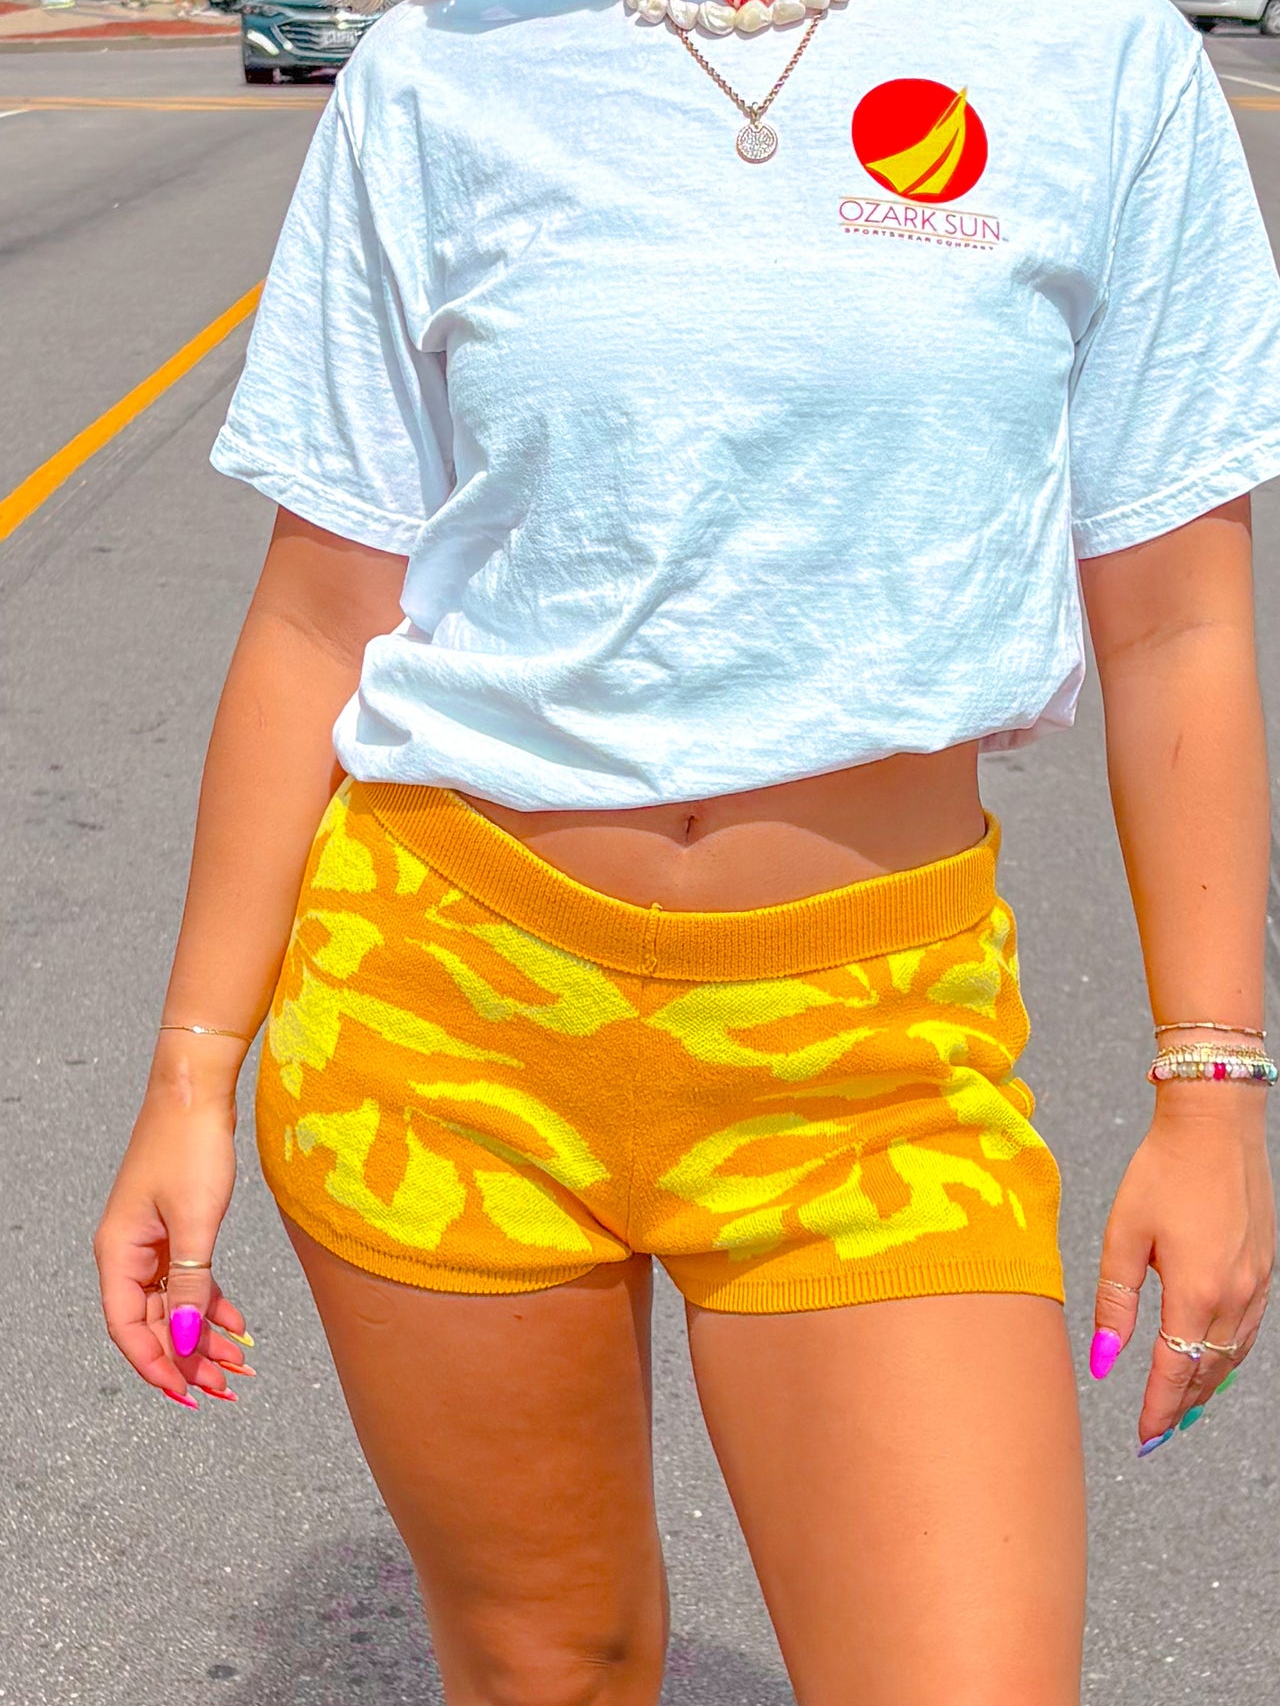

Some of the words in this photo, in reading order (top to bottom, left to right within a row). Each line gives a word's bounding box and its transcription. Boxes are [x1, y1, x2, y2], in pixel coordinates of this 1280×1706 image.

[838, 200, 937, 232] OZARK
[945, 213, 1000, 241] SUN
[844, 227, 931, 243] SPORTSWEAR
[936, 238, 994, 251] COMPANY
